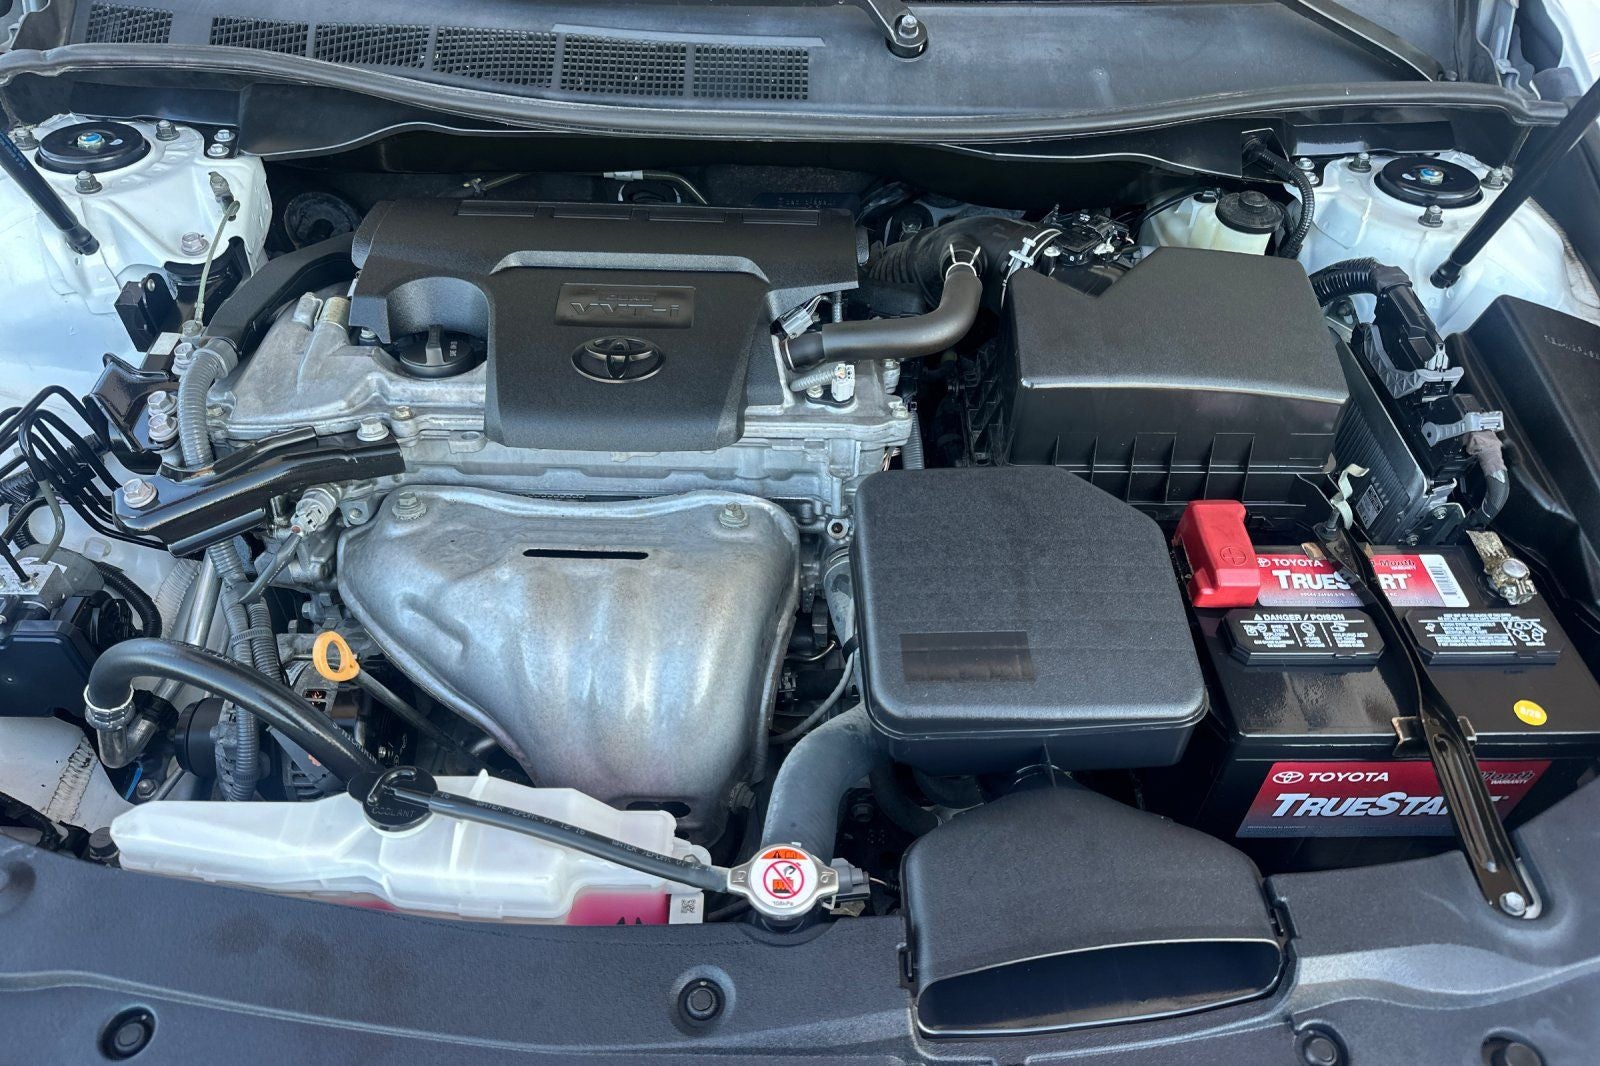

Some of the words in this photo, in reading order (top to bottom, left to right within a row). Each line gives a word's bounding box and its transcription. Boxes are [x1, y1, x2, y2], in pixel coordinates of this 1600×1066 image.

[1272, 558, 1323, 567] TOYOTA
[1262, 613, 1302, 621] DANGER
[1311, 613, 1345, 621] POISON
[1308, 772, 1389, 782] TOYOTA
[371, 806, 417, 818] COOLANT
